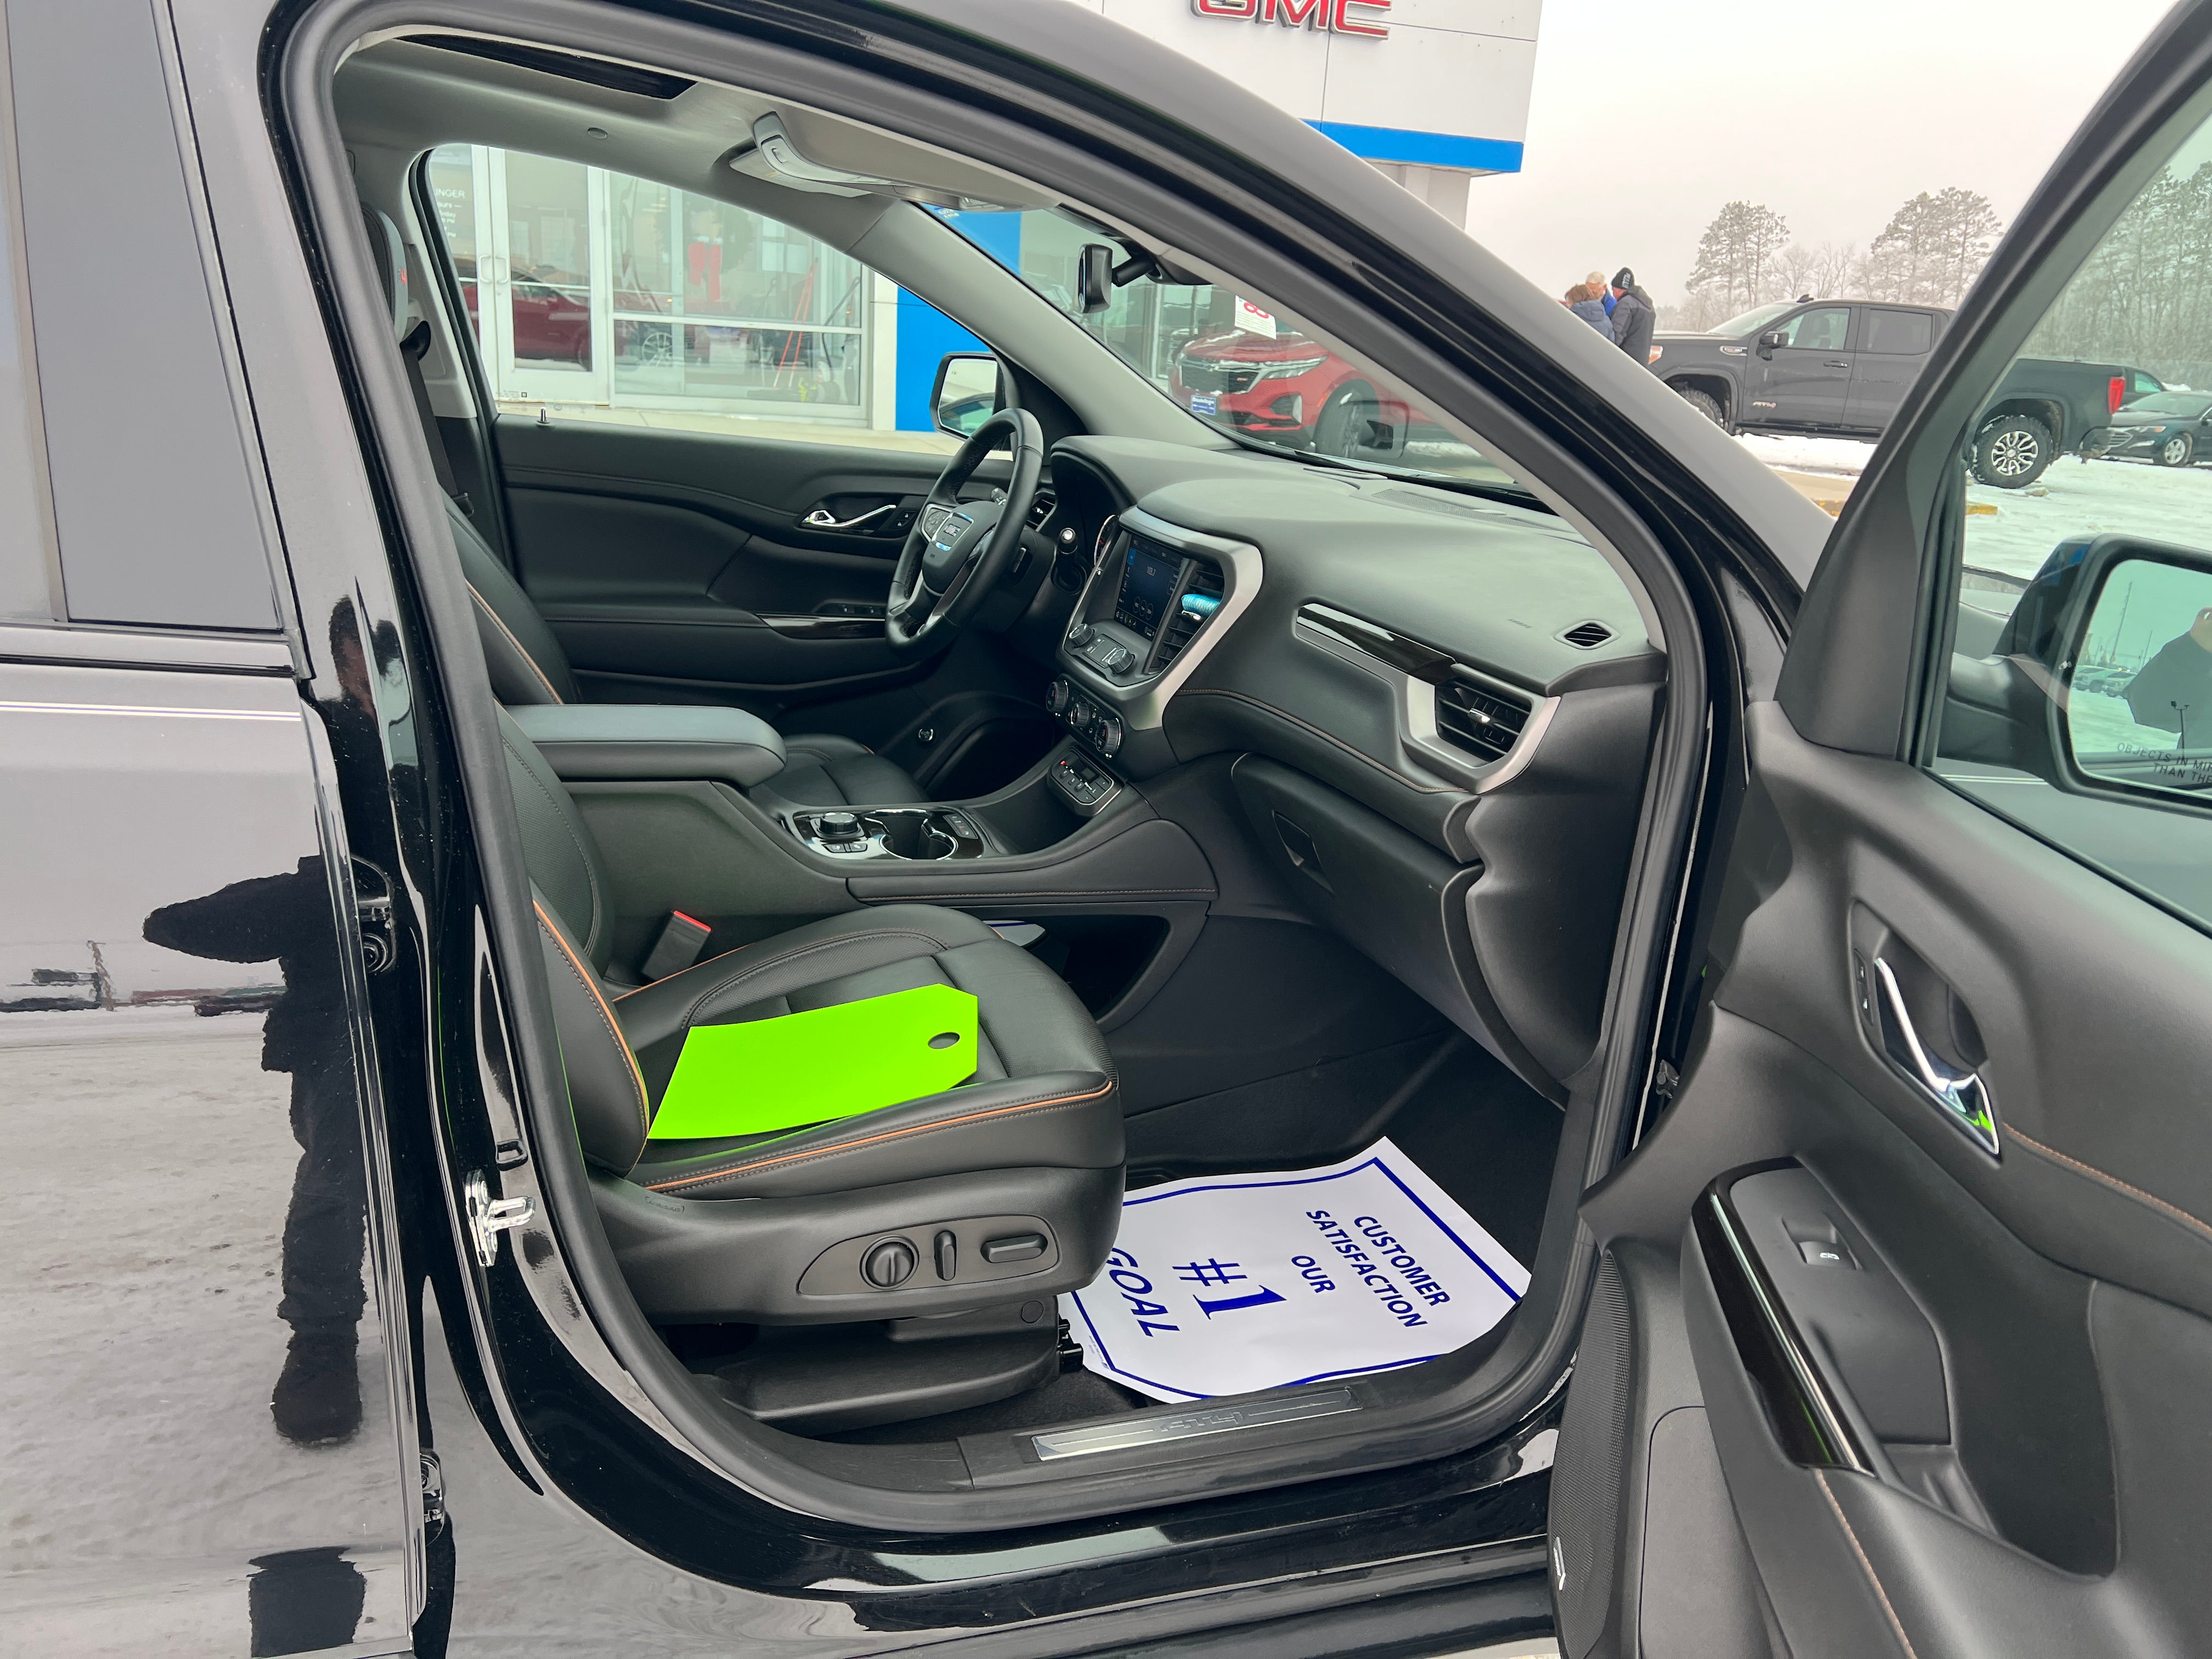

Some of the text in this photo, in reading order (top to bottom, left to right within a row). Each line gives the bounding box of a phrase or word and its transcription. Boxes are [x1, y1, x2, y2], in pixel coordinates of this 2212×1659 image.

[2117, 742, 2171, 762] OBJECTS
[2176, 756, 2190, 766] IN
[2154, 763, 2186, 778] THAN
[1172, 1258, 1288, 1320] #1
[1291, 1255, 1336, 1293] OUR
[1305, 1210, 1428, 1327] SATISFACTION
[1354, 1216, 1451, 1306] CUSTOMER
[1106, 1247, 1180, 1338] GOAL
